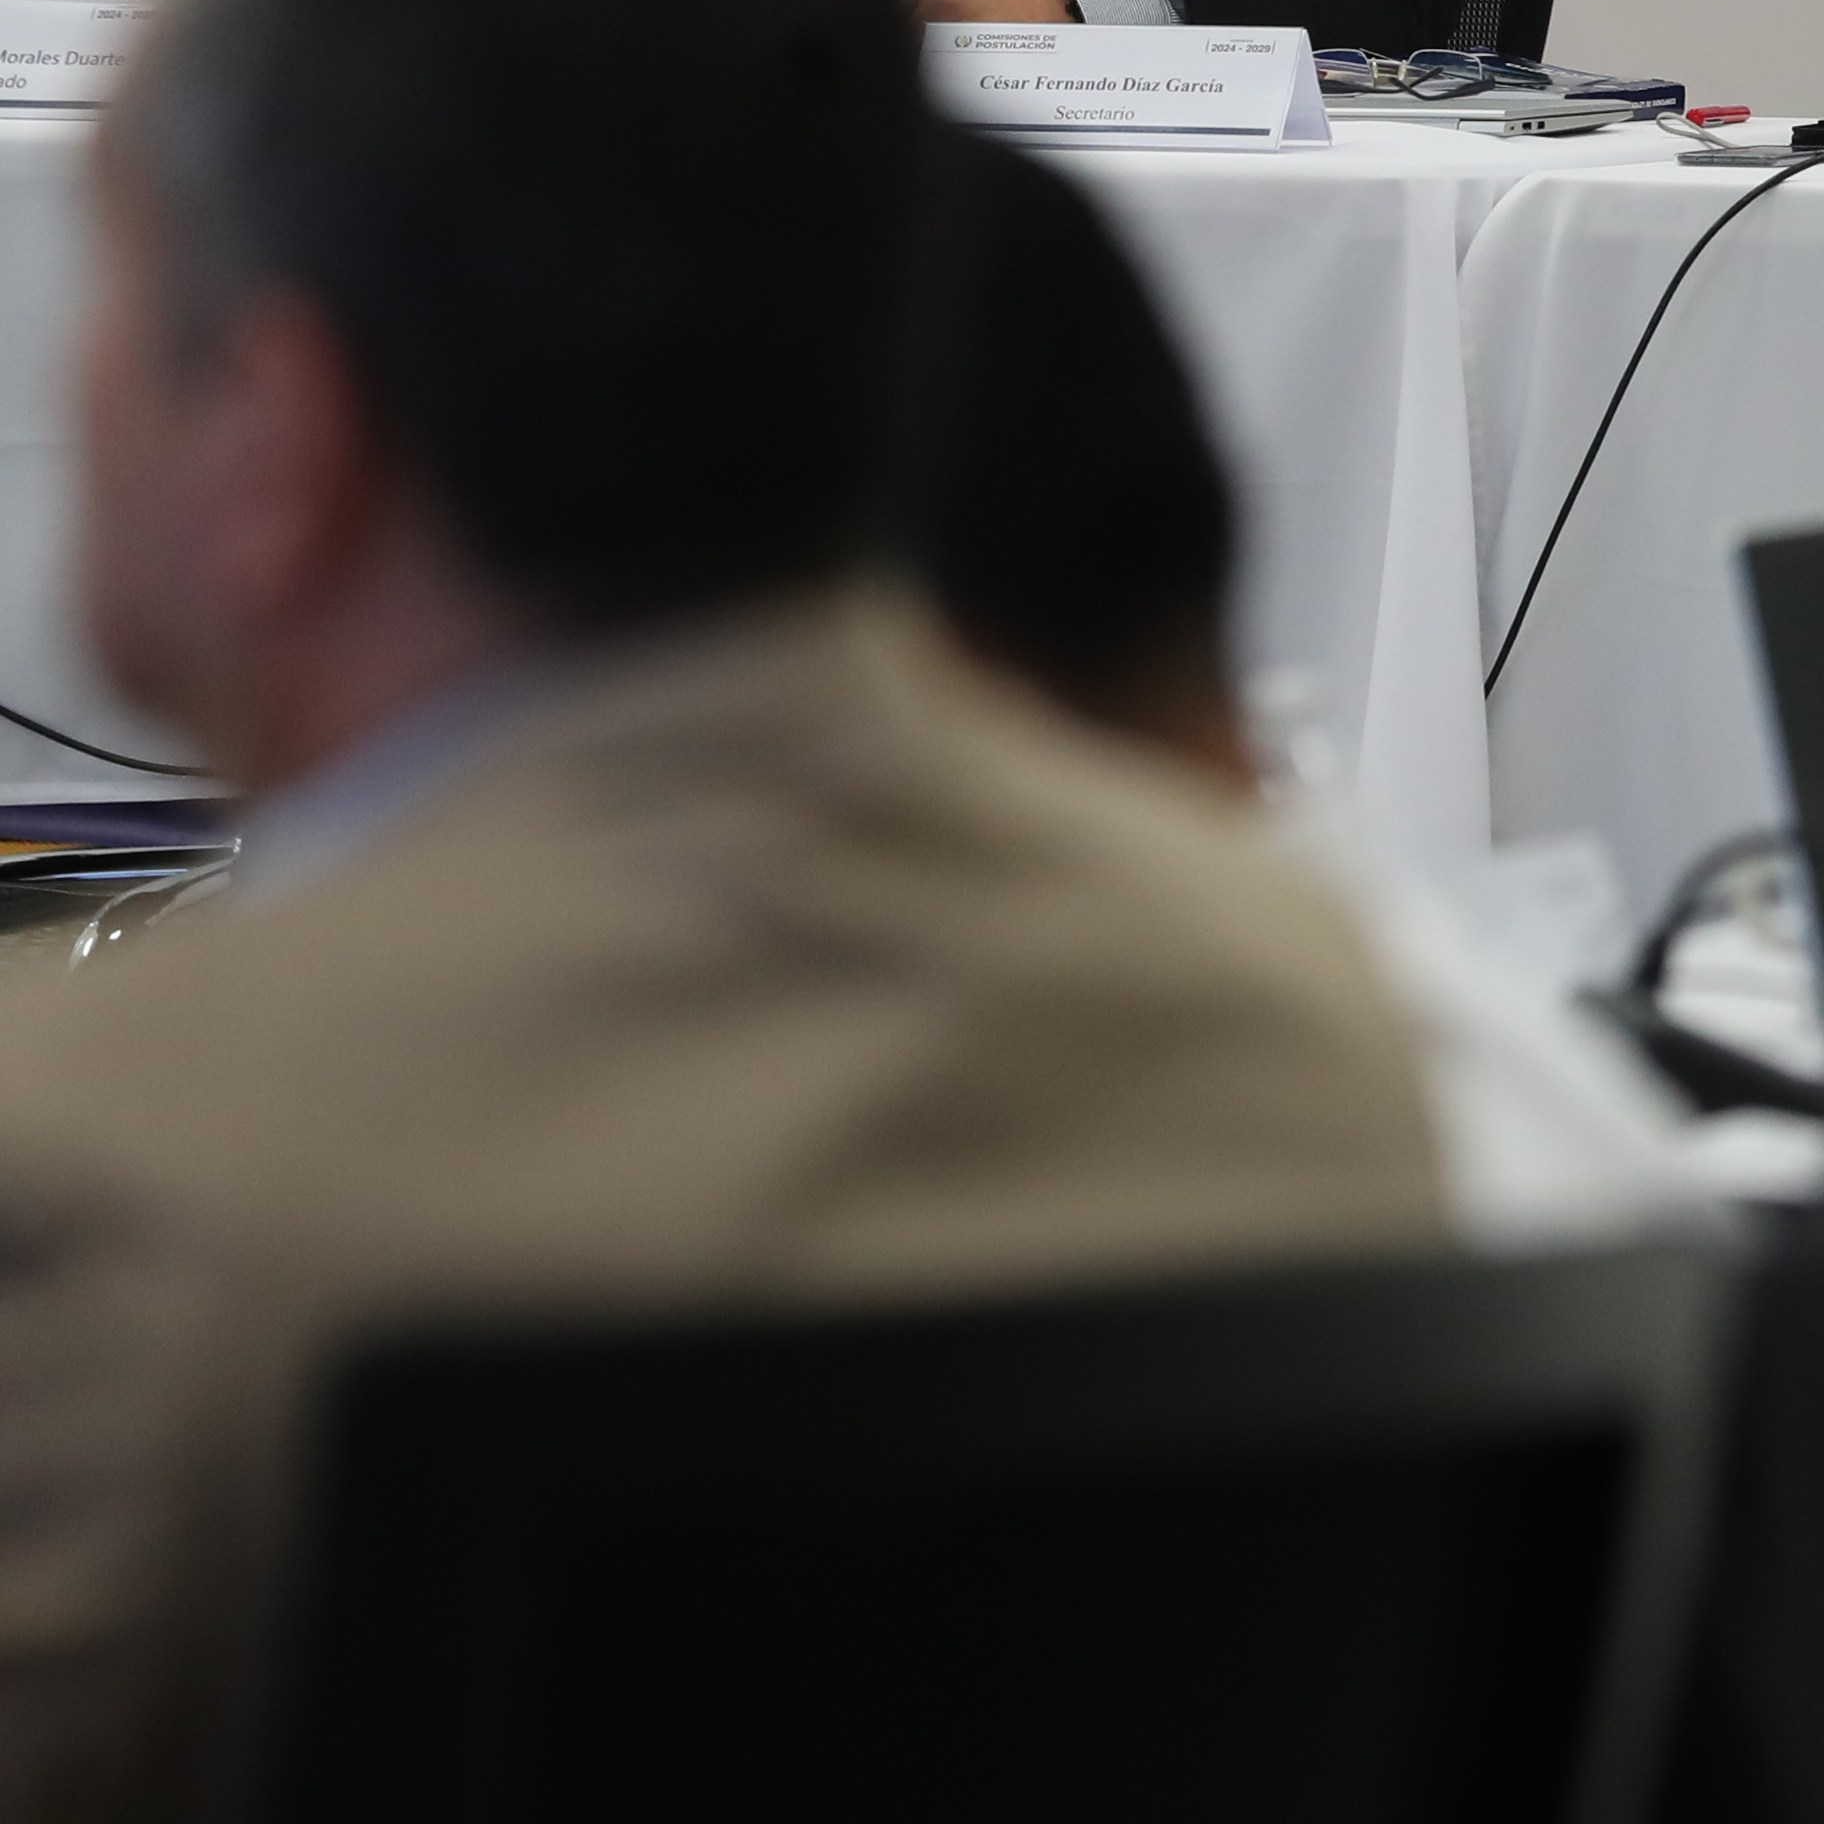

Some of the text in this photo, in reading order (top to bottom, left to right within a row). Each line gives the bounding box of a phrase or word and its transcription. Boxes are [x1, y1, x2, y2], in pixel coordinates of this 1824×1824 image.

[976, 33, 1058, 42] COMISIONES DE
[975, 40, 1056, 50] POSTULACIÓN
[1211, 44, 1236, 53] 2024
[1245, 44, 1271, 53] 2029
[64, 51, 126, 67] Duarte
[980, 74, 1225, 94] César Fernando Díaz García
[1054, 104, 1136, 121] Secretario
